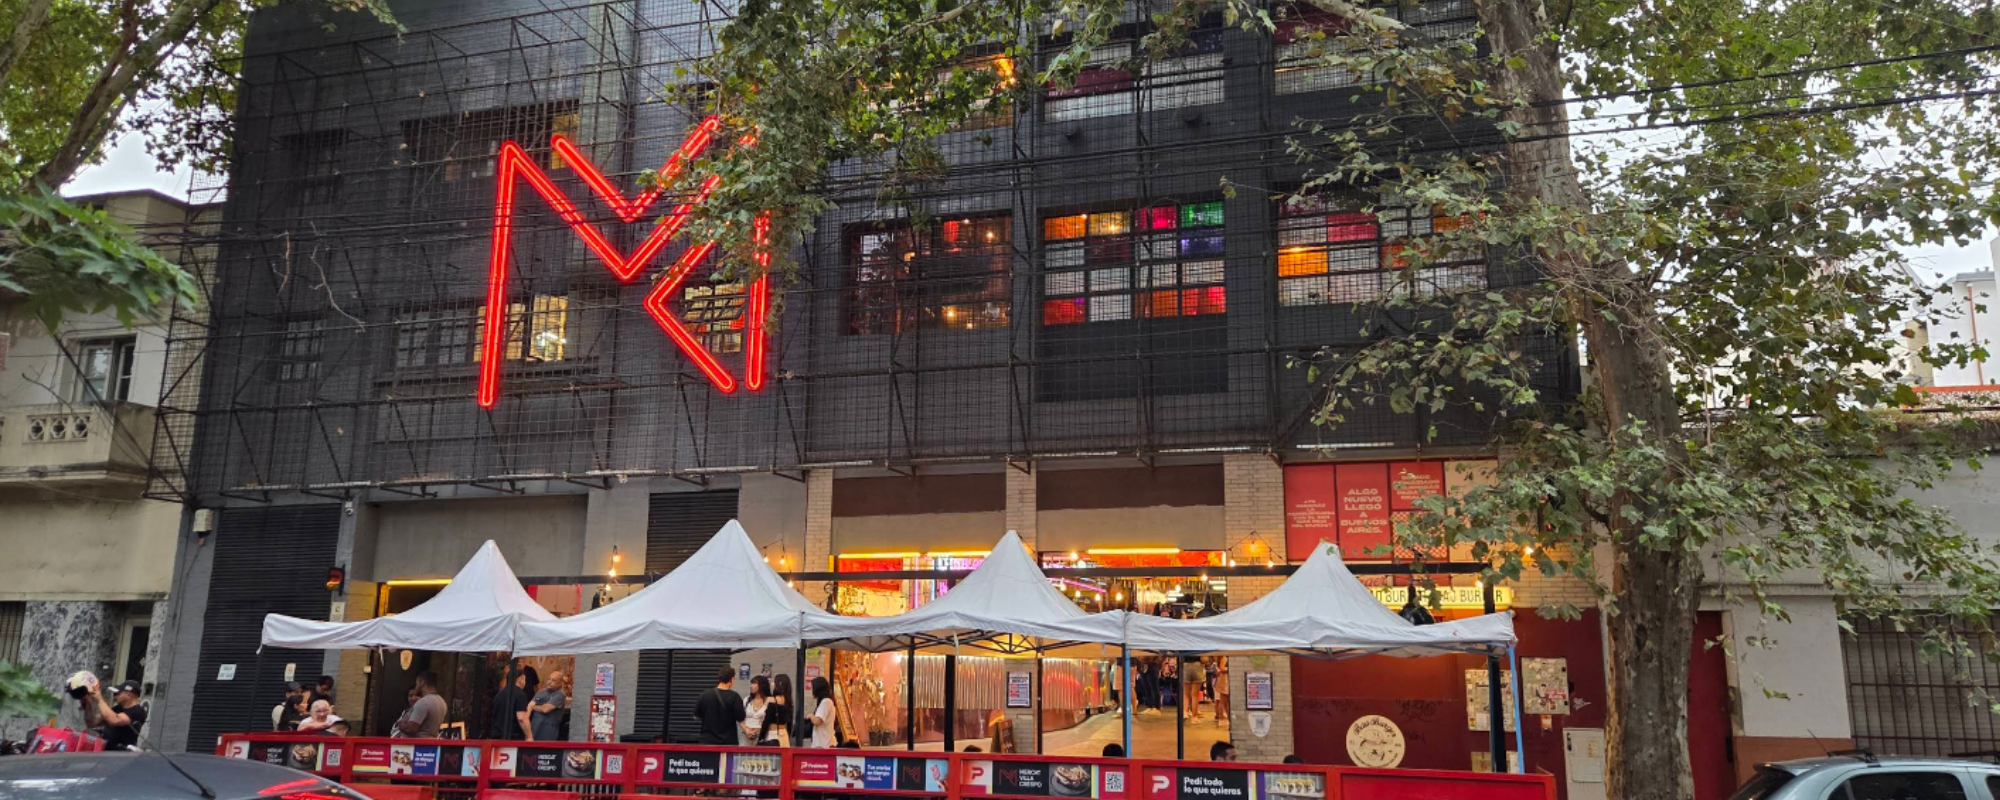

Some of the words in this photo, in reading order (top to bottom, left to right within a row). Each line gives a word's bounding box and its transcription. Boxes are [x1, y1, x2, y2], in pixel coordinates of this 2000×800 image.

[1460, 589, 1503, 603] BURR
[669, 758, 684, 767] Pedí
[684, 759, 700, 768] todo
[675, 768, 688, 776] que
[689, 768, 714, 776] quieras
[1184, 776, 1203, 786] Pedí
[1204, 777, 1223, 786] todo
[1183, 785, 1192, 793] lo
[1193, 787, 1209, 796] que
[1210, 786, 1242, 796] quieras
